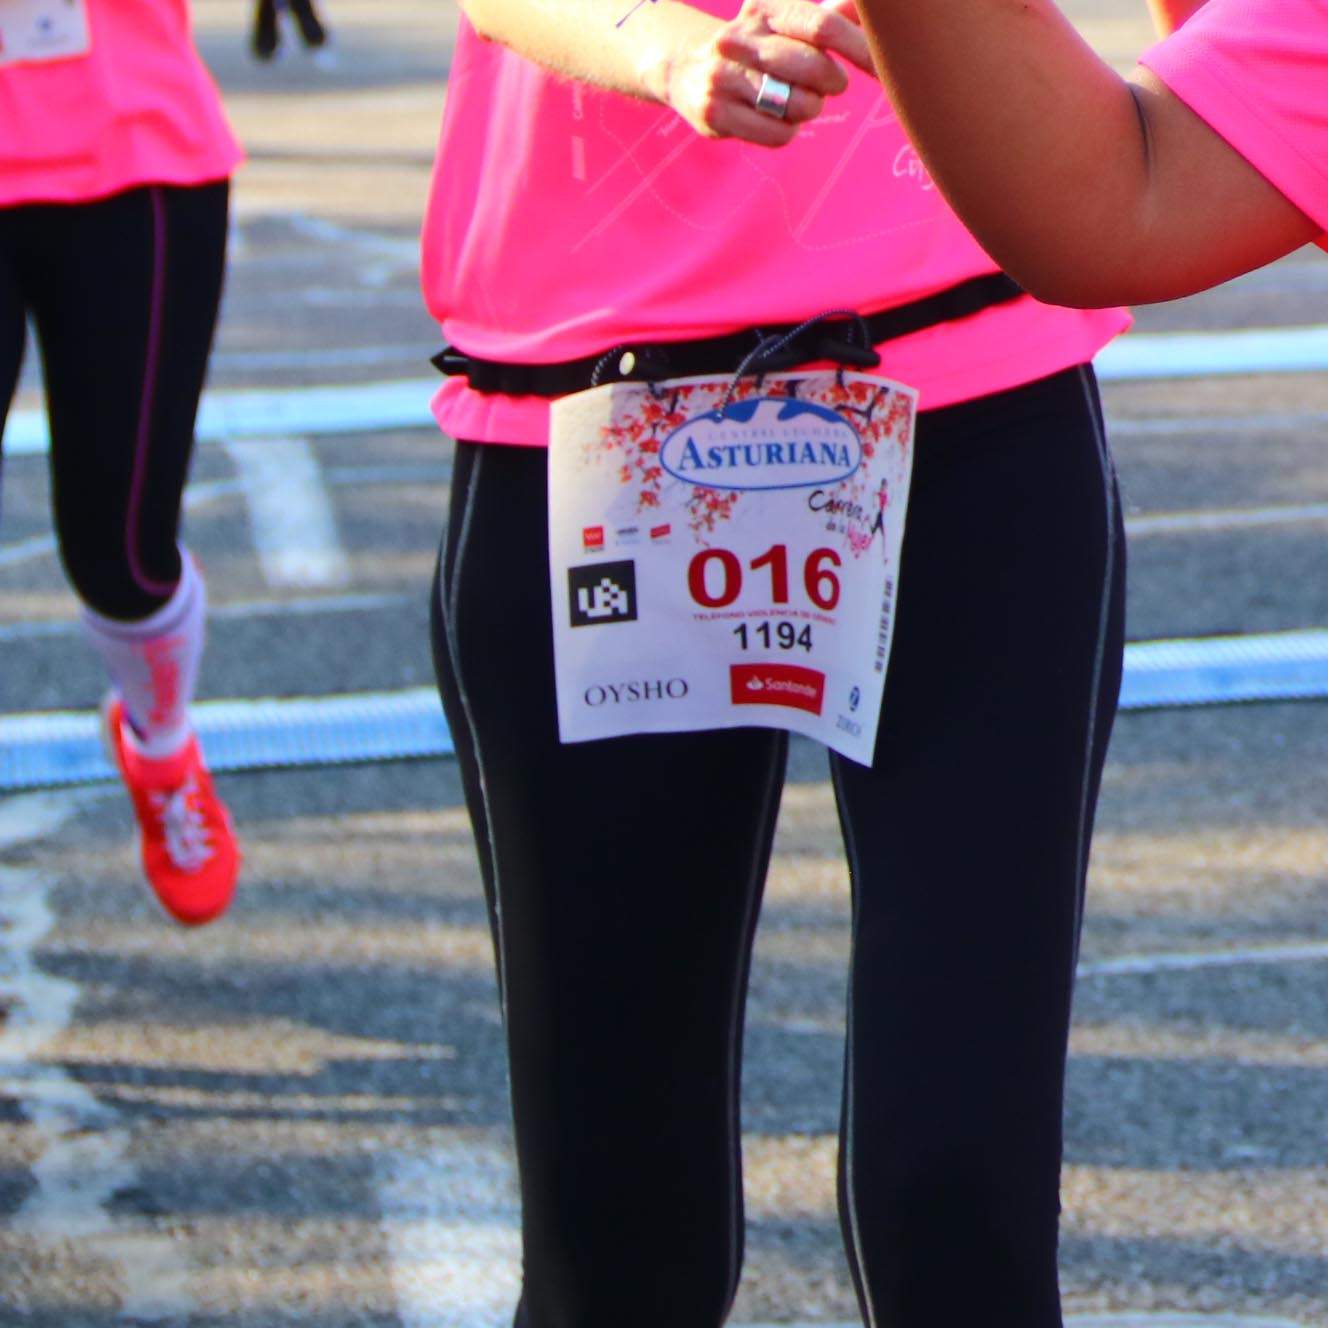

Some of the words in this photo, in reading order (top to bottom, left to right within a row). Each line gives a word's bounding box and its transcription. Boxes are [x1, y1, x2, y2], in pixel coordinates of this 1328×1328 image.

[676, 436, 852, 471] ASTURIANA
[687, 543, 842, 612] 016
[733, 621, 813, 654] 1194
[584, 677, 690, 708] OYSHO
